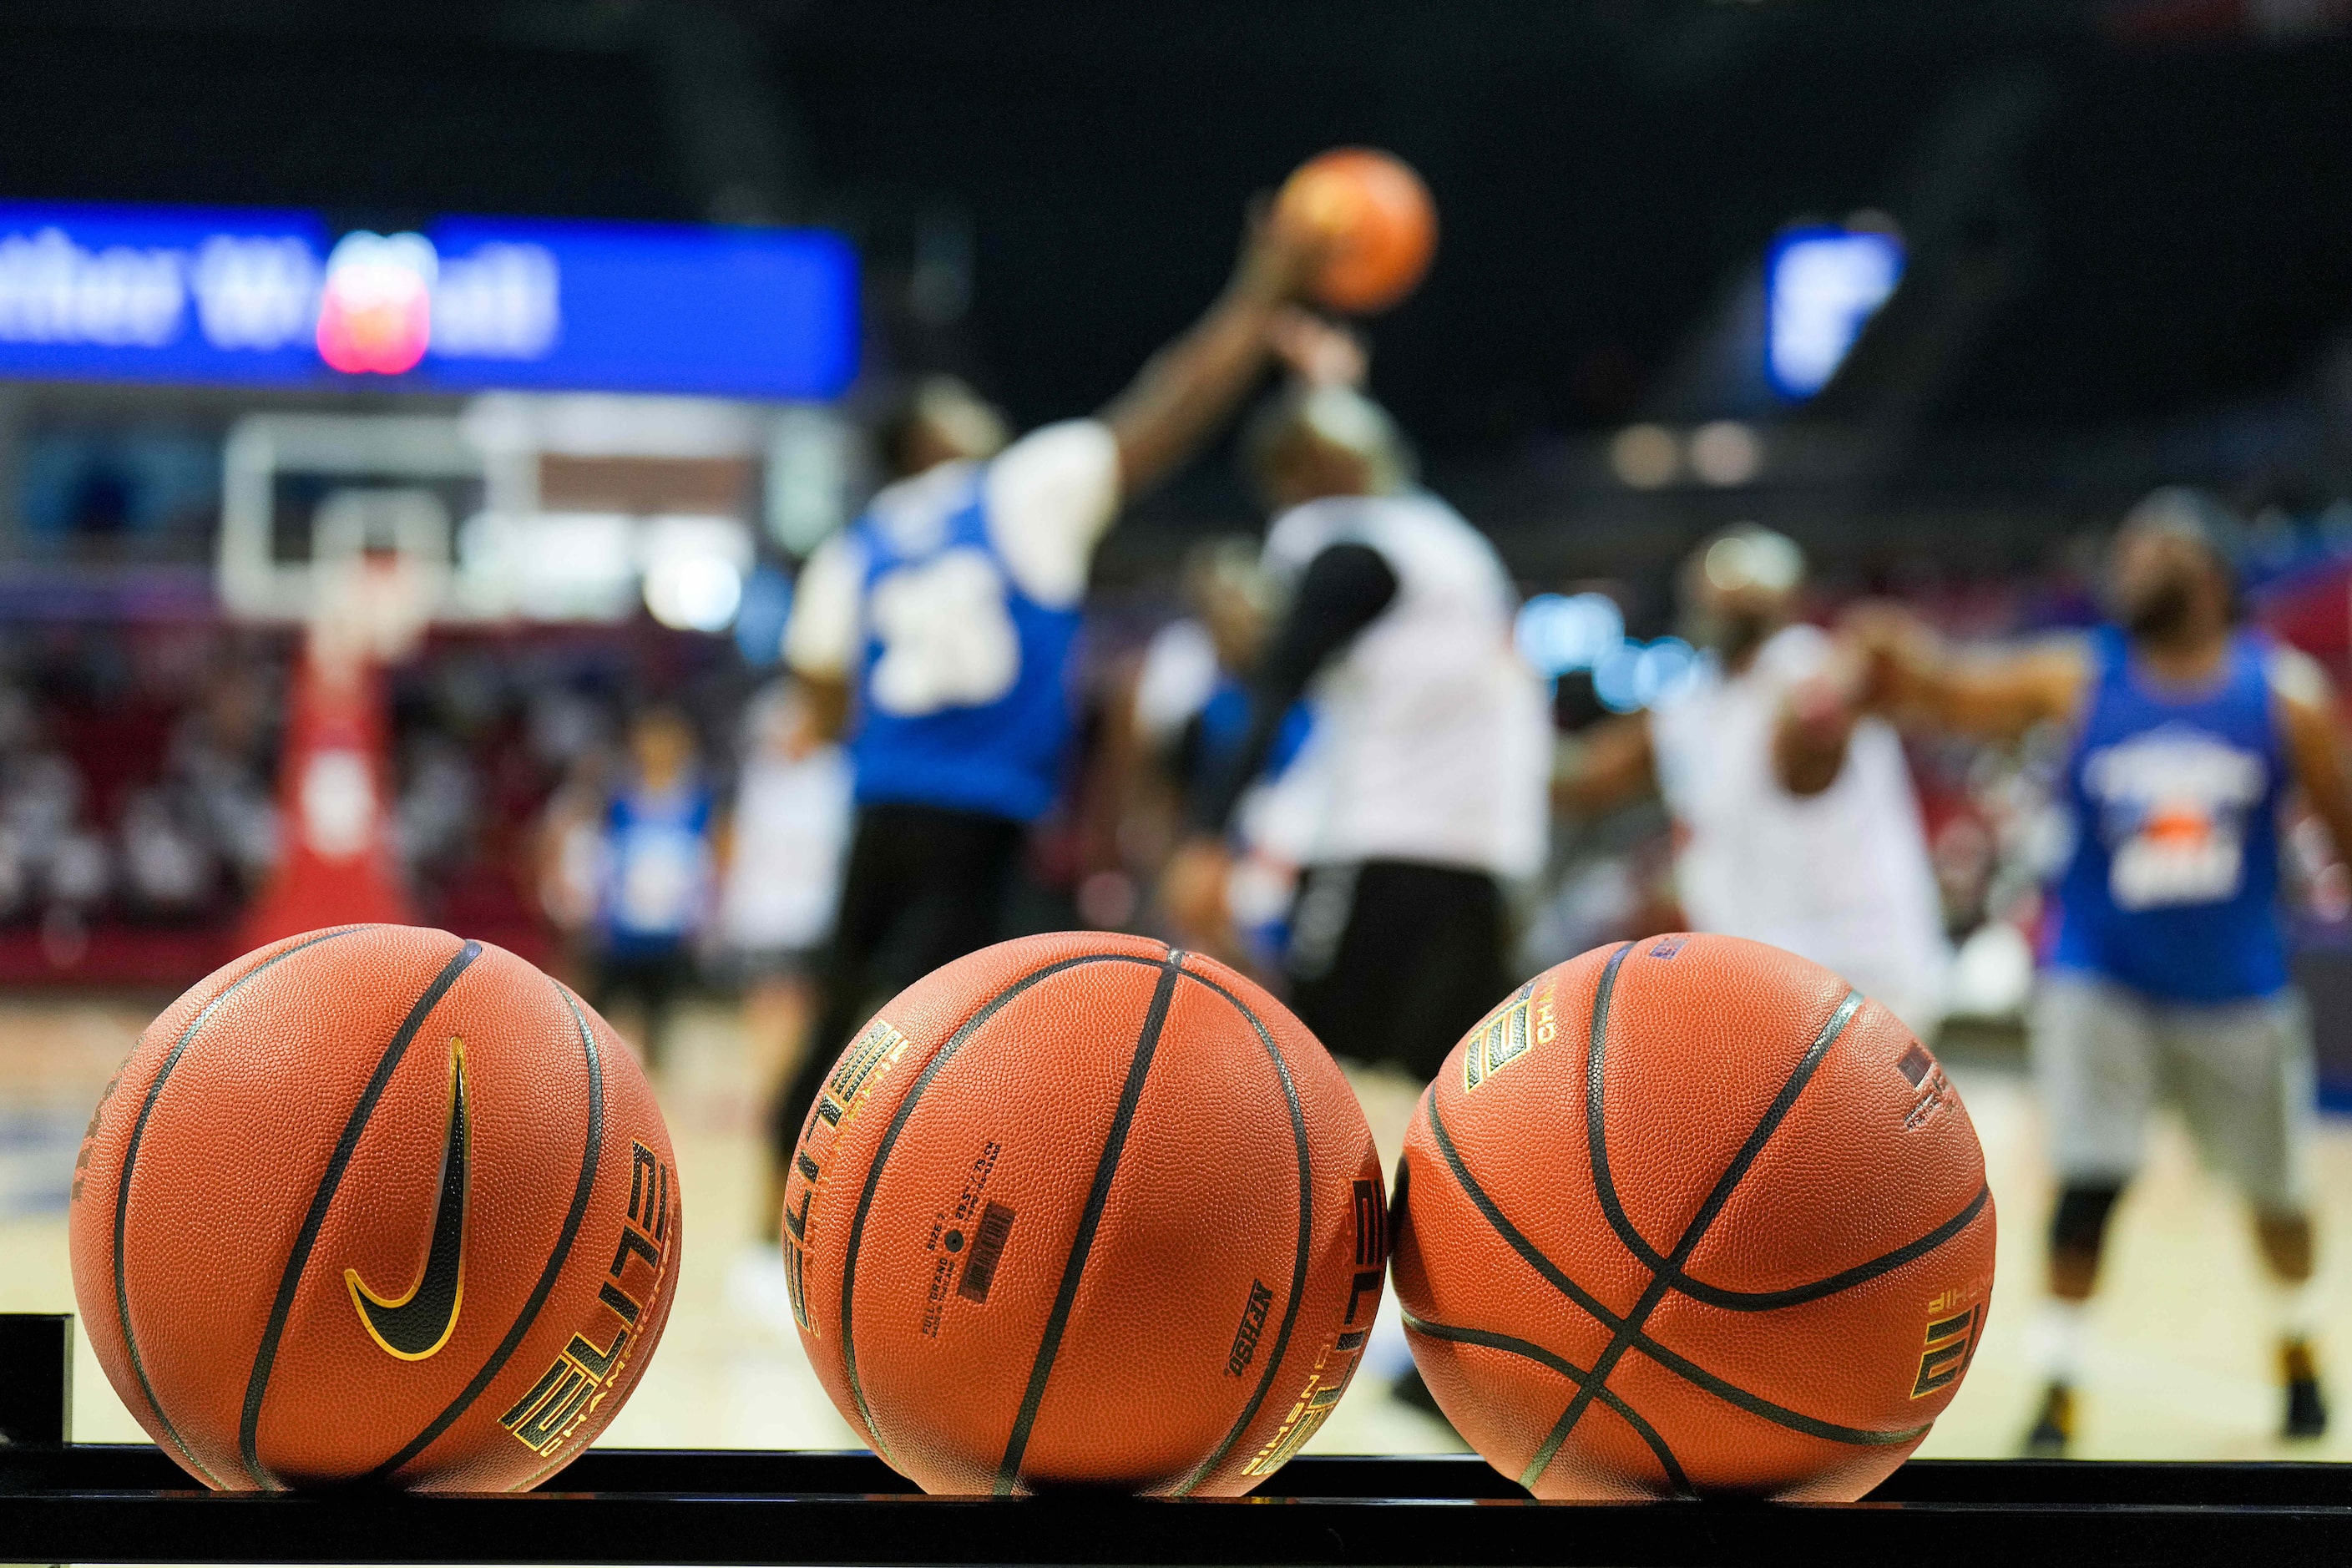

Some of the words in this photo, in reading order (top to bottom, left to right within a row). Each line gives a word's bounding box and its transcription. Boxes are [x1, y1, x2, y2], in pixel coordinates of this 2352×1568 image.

[974, 1159, 986, 1172] 75
[928, 1223, 942, 1251] SIZE
[498, 1138, 666, 1453] ELITE
[922, 1257, 948, 1335] FULL/GRAND
[931, 1313, 941, 1338] MADE
[939, 1262, 955, 1302] THAILAND
[1232, 1279, 1274, 1369] NFHS
[1252, 1180, 1387, 1475] ELITE
